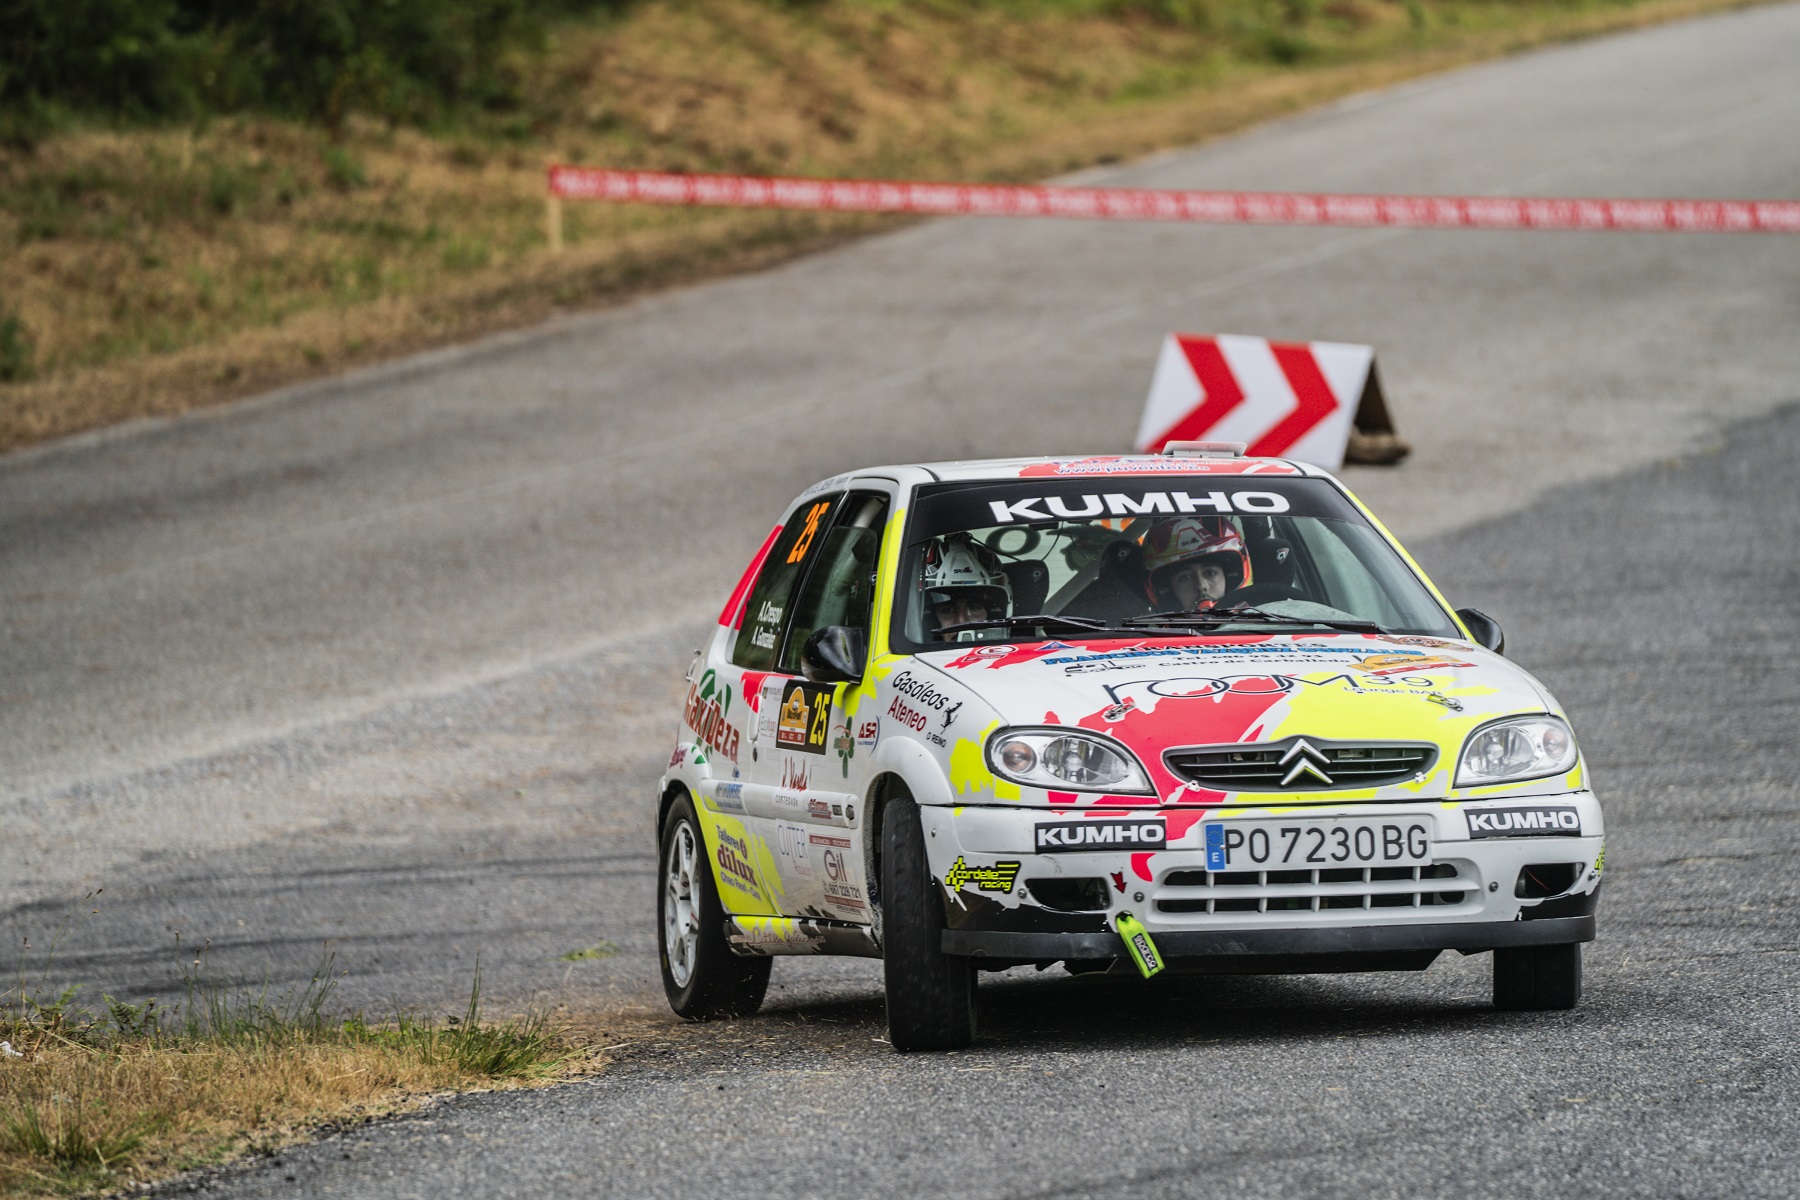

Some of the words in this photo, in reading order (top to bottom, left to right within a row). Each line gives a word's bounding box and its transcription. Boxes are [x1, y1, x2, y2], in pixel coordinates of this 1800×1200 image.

[988, 491, 1290, 523] KUMHO
[786, 502, 830, 563] 25
[1041, 650, 1181, 665] FRANCISCO
[1122, 642, 1327, 652] TRANSPORTES
[892, 670, 949, 710] Gasóleos
[809, 691, 831, 746] 25
[887, 695, 927, 732] Ateneo
[857, 722, 877, 739] ASR
[931, 733, 947, 748] REINO
[1469, 811, 1580, 832] KUMHO
[1037, 824, 1165, 847] KUMHO
[1280, 826, 1376, 864] 7230
[1382, 824, 1428, 861] BG
[717, 844, 758, 887] dilux
[823, 849, 848, 882] Gil
[1211, 852, 1220, 863] E
[979, 880, 1012, 892] racing
